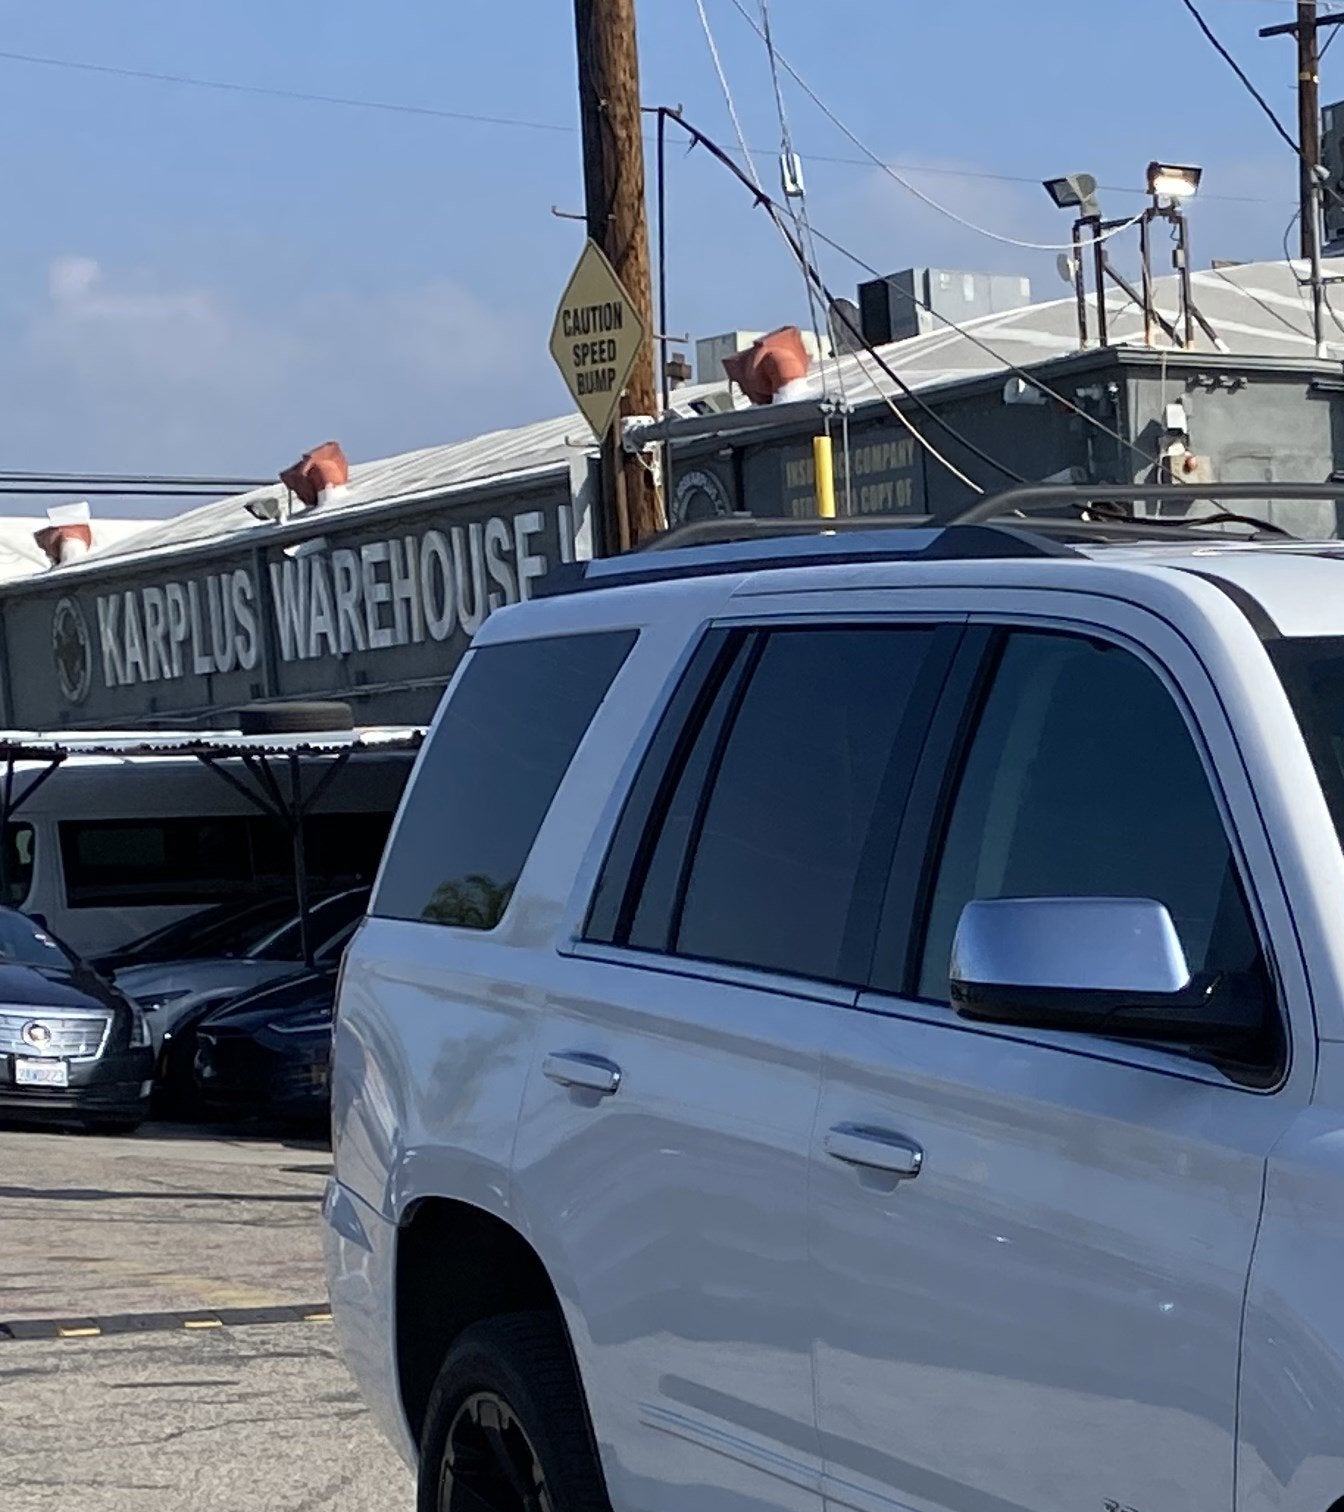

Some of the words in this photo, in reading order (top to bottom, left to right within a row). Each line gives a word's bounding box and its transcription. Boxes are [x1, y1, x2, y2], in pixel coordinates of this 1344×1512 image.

[562, 302, 623, 337] CAUTION
[573, 339, 617, 367] SPEED
[576, 368, 617, 396] BUMP
[96, 568, 259, 687] KARPLUS
[269, 511, 548, 662] WAREHOUSE
